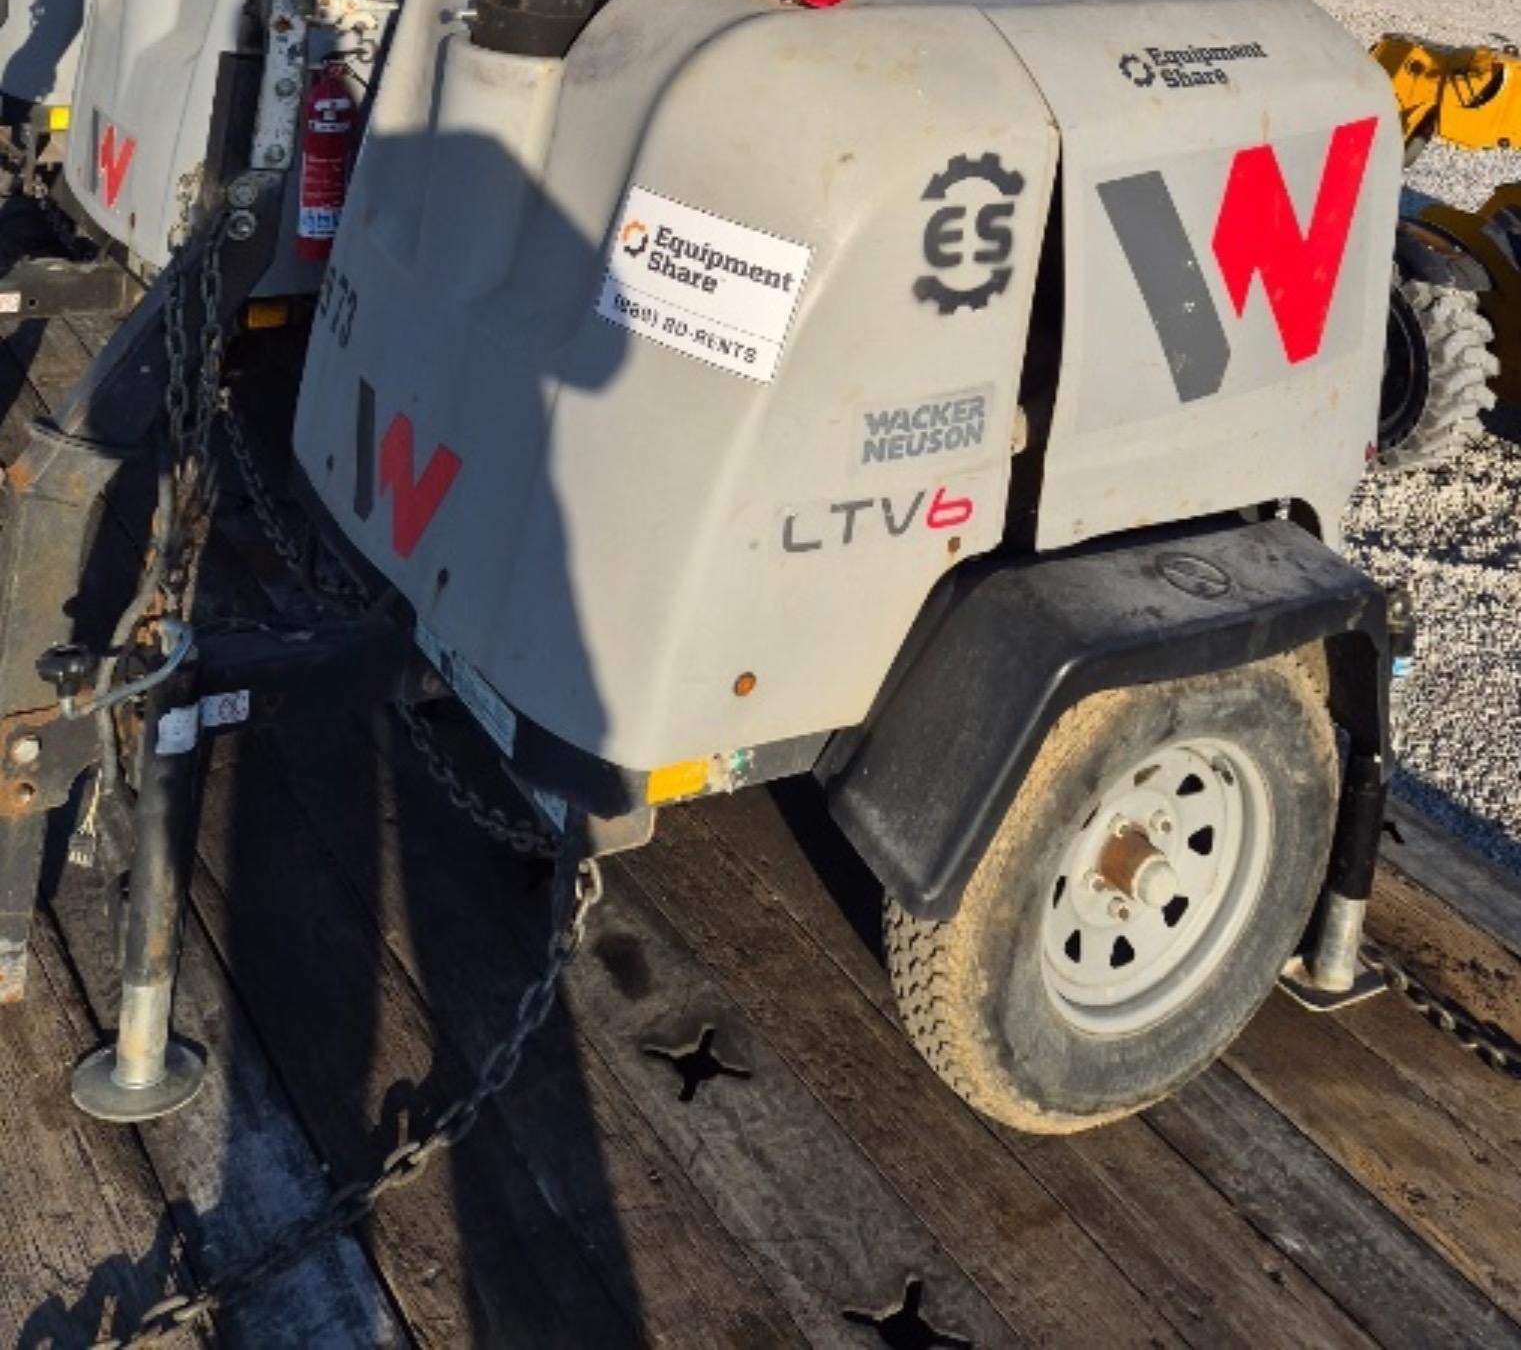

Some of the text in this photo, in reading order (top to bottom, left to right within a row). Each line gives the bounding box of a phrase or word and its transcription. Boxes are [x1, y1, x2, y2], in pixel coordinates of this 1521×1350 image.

[1146, 41, 1269, 66] Equipment
[1160, 66, 1228, 88] Share
[923, 201, 1016, 269] ES
[647, 250, 719, 295] Share
[653, 224, 796, 293] Equipment
[863, 394, 986, 437] WACKER
[861, 422, 985, 465] NEUSON
[781, 486, 974, 554] LTV6
